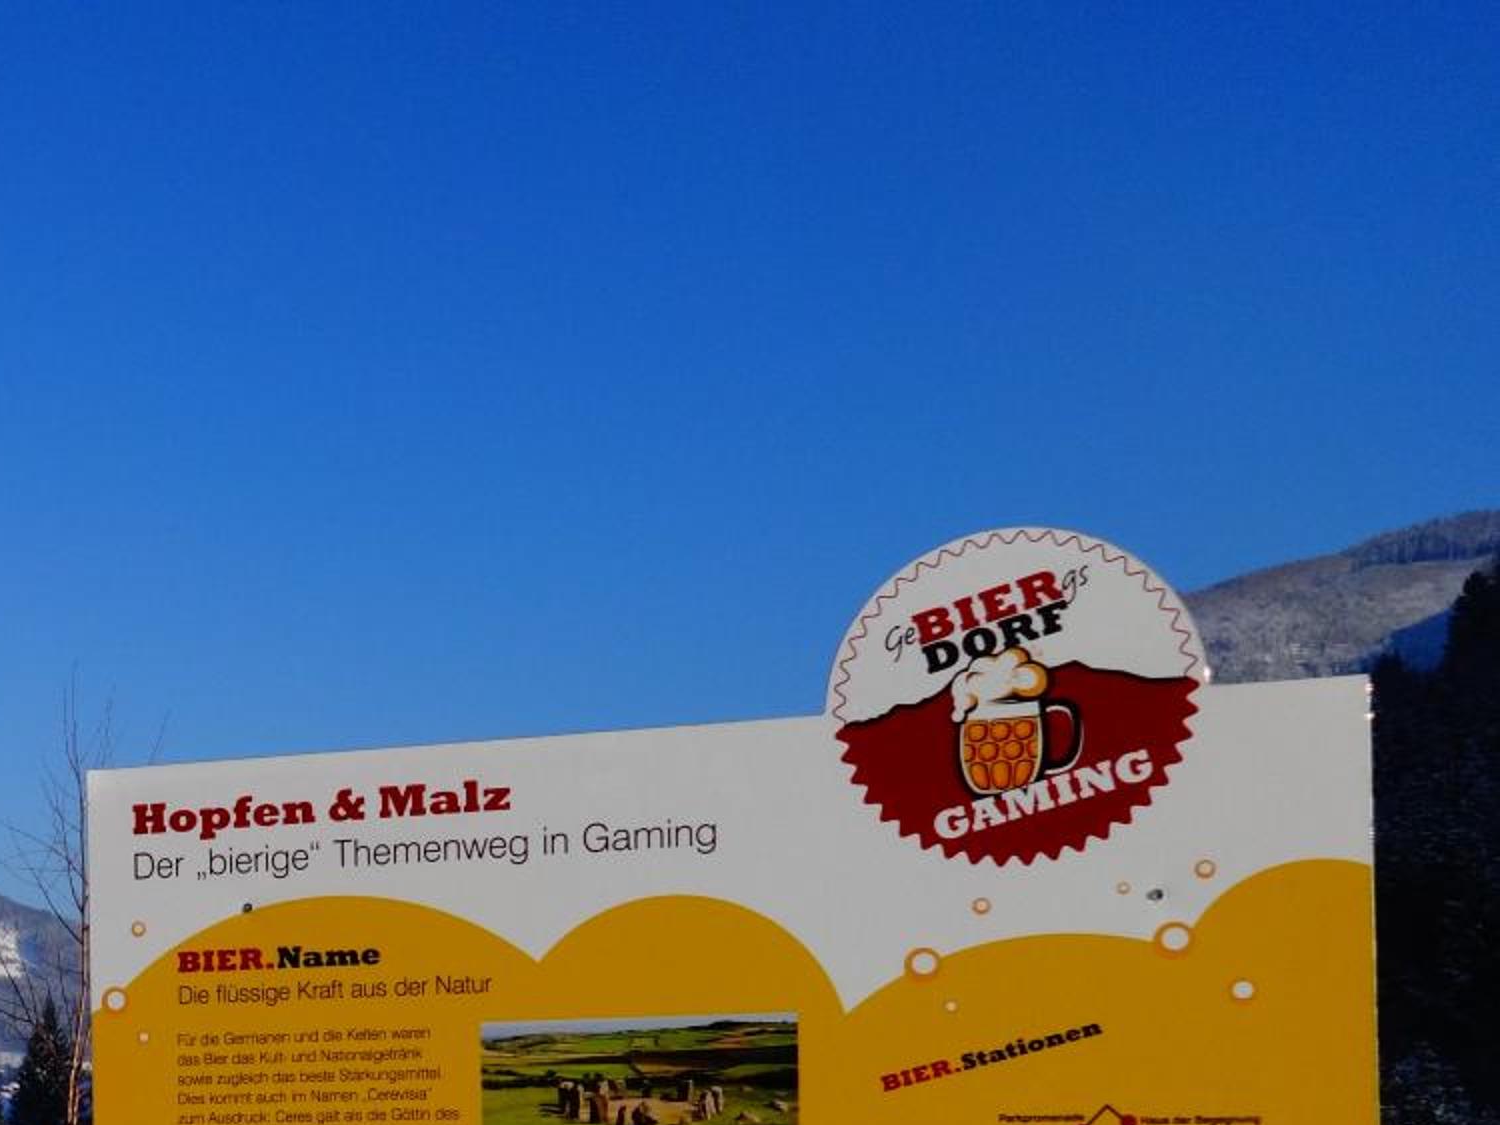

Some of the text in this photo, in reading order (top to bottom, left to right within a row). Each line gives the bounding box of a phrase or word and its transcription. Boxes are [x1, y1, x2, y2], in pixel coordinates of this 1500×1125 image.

[922, 600, 1068, 673] DORF
[133, 781, 511, 839] Hopfen & Malz
[934, 749, 1153, 838] GAMING
[134, 818, 717, 880] Der „bierige“ Themenweg in Gaming
[177, 946, 380, 973] BIER.Name
[178, 973, 492, 1005] Die flüssige Kraft aus der Natur
[881, 1023, 1103, 1092] BIER.Stationen
